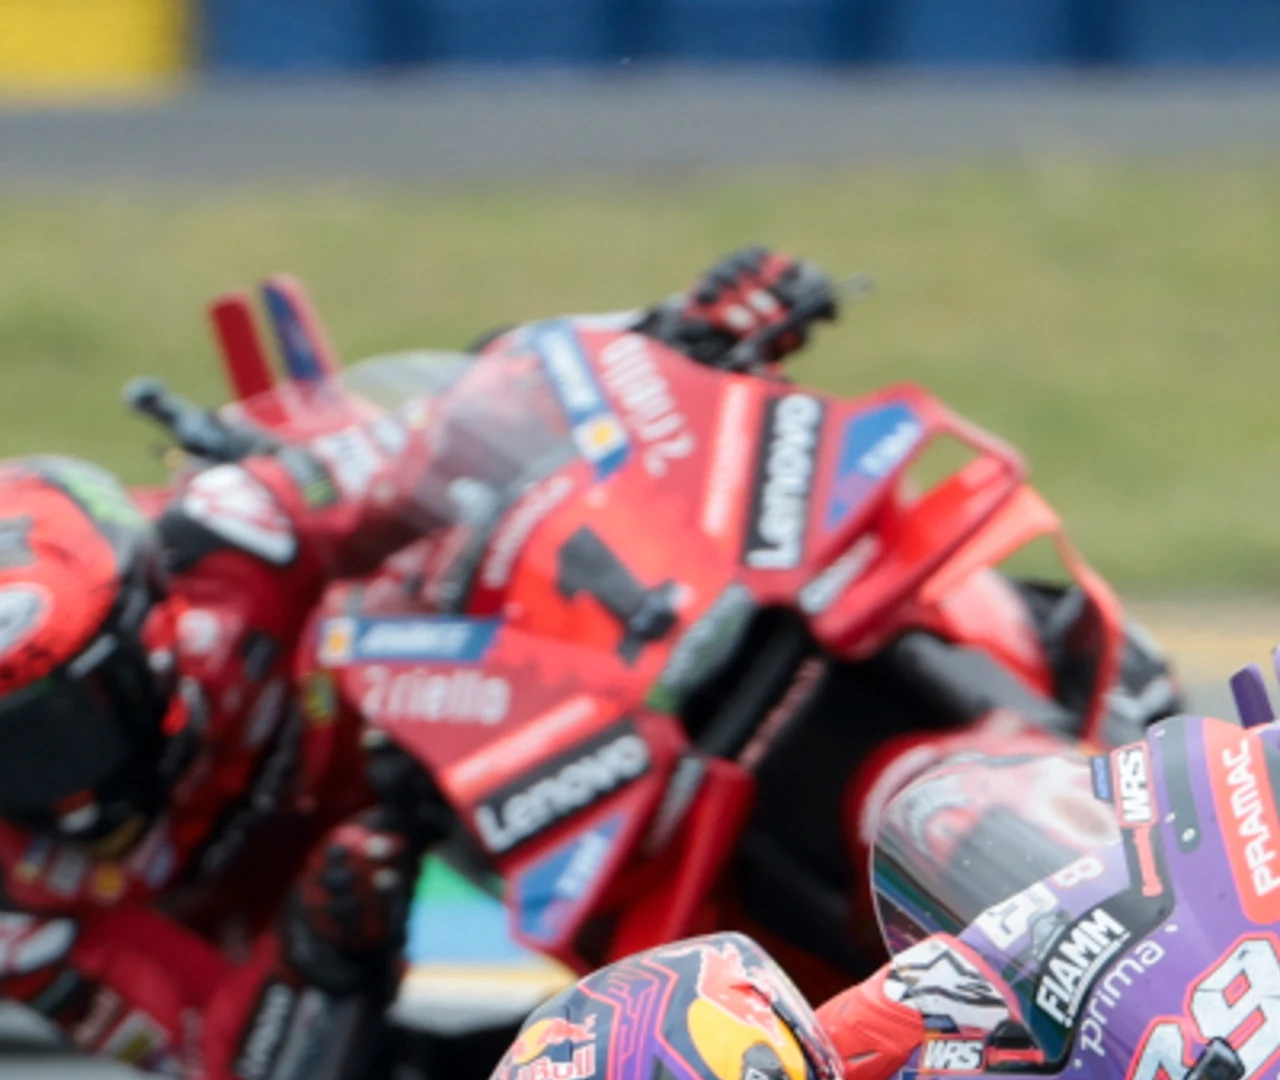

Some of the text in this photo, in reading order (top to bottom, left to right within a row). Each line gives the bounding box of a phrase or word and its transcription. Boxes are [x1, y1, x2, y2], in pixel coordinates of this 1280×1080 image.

[746, 393, 822, 570] Lenovo
[475, 735, 649, 854] Lenovo
[1117, 749, 1153, 823] WRS
[1035, 908, 1125, 1026] FIAMM
[1081, 939, 1166, 1057] prima
[923, 1038, 985, 1071] WRS
